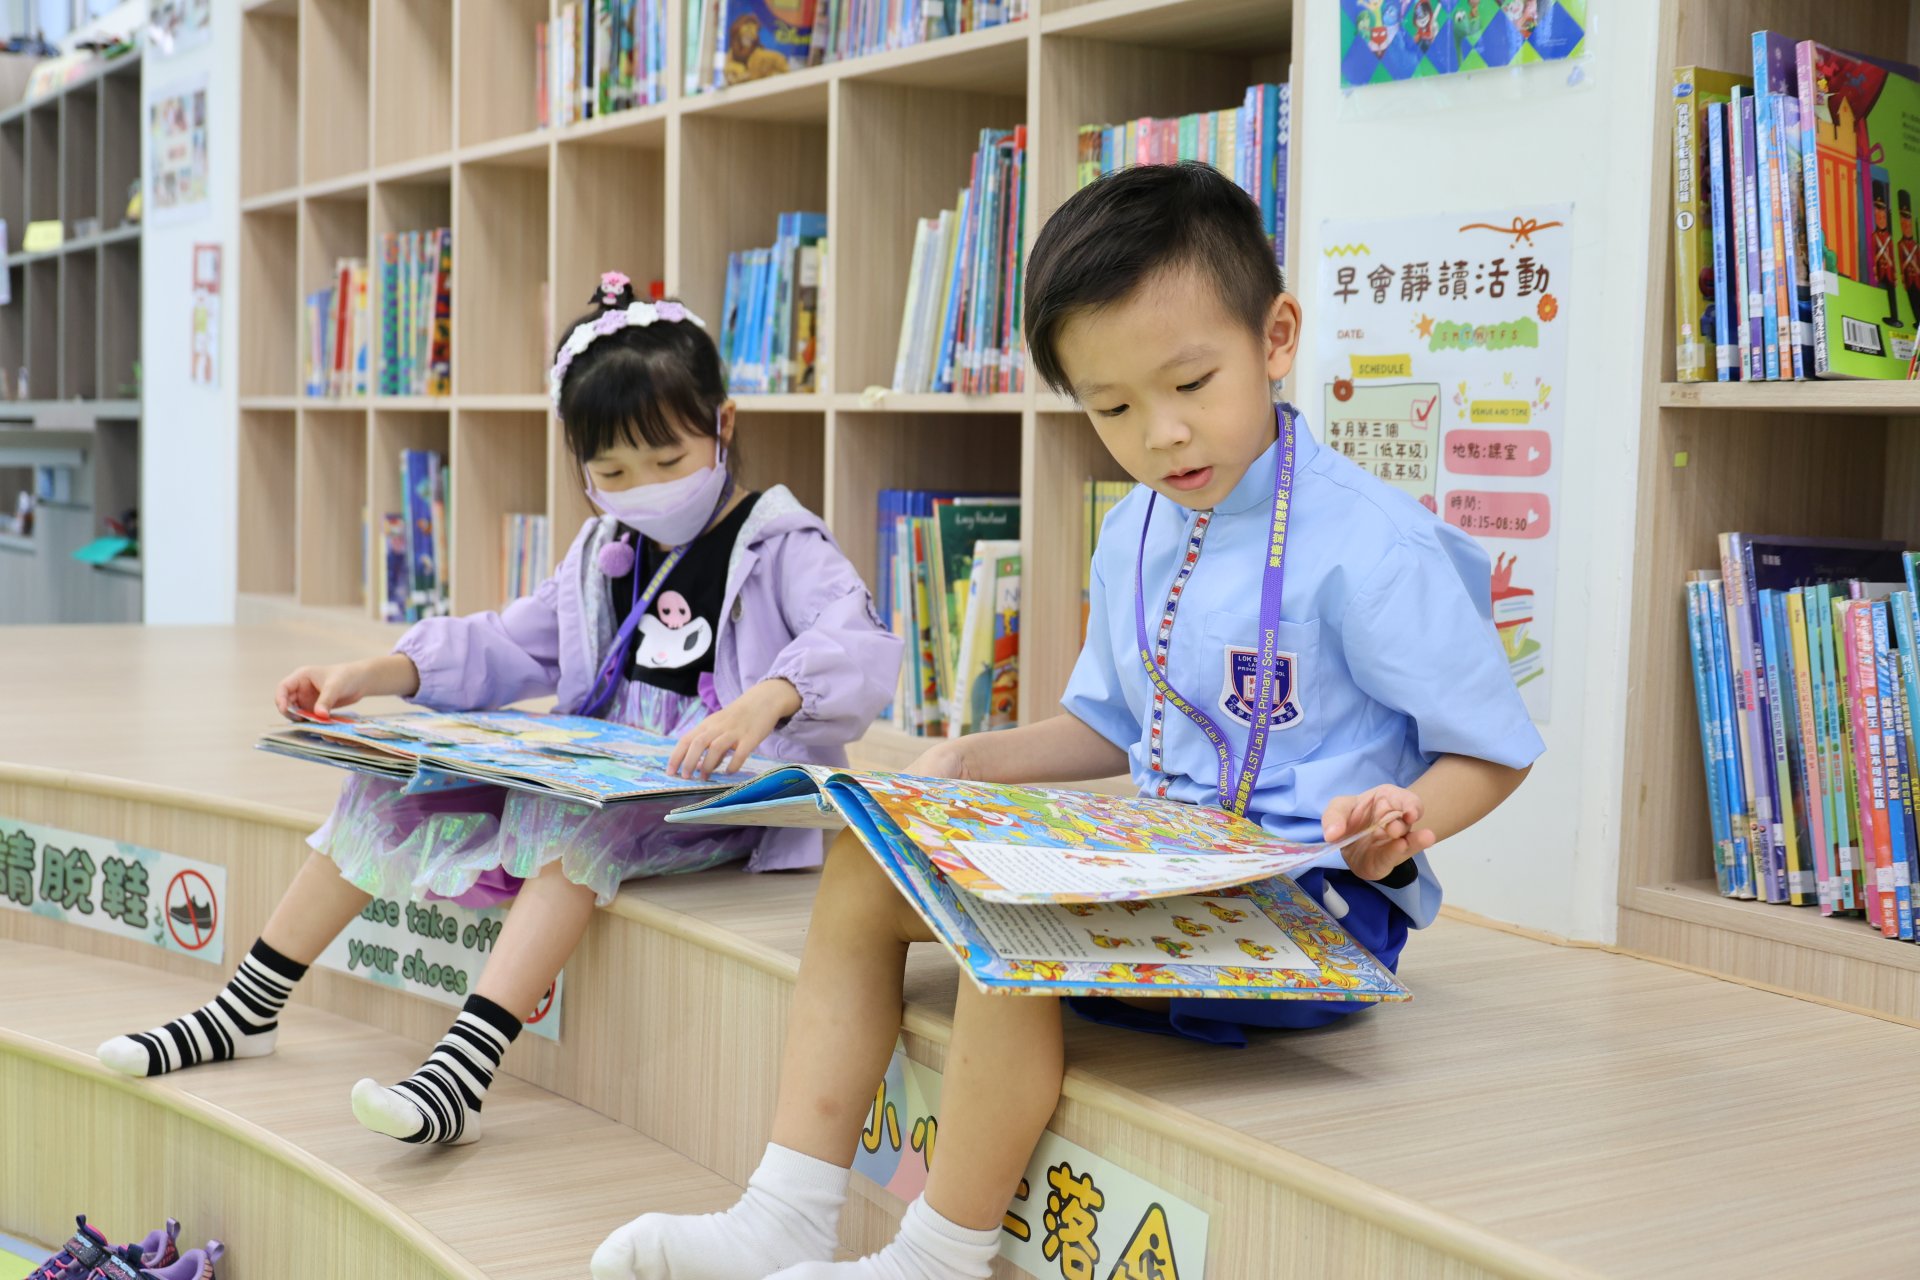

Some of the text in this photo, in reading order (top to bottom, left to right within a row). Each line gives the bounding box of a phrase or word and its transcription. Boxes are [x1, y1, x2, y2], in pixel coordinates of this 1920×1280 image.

[1333, 257, 1549, 304] 早會靜讀活動
[1358, 363, 1404, 375] SCHEDULE
[1511, 408, 1528, 416] TIME
[1330, 421, 1399, 438] 每月第三個
[1284, 434, 1293, 449] Tak
[1283, 450, 1293, 468] Lau
[1281, 469, 1291, 487] LST
[1460, 514, 1527, 531] 08:15-08:30
[1262, 629, 1274, 667] School
[1258, 670, 1273, 710] Primary
[1191, 712, 1209, 730] LST
[1255, 711, 1267, 730] Tak
[1205, 724, 1220, 743] Lau
[1253, 732, 1263, 750] Lau
[1217, 743, 1228, 761] Tak
[1247, 750, 1258, 771] LST
[1219, 761, 1229, 797] Primary
[0, 829, 150, 929] 請脫鞋
[405, 900, 458, 944] take
[348, 938, 468, 996] your shoes
